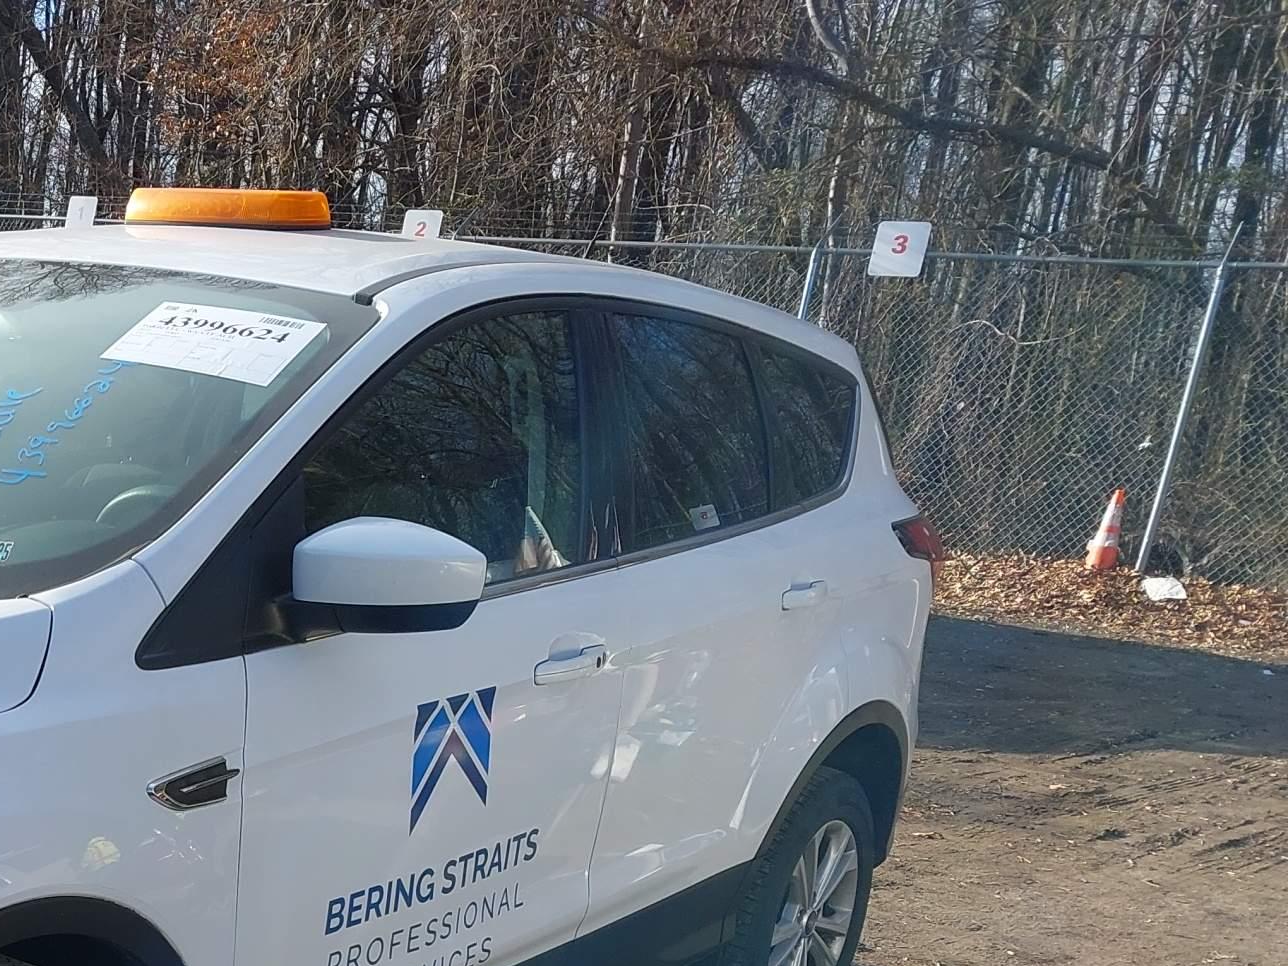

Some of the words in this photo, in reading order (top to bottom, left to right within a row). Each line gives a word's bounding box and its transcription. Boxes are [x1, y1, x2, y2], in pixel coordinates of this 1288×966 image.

[414, 221, 427, 237] 2
[891, 234, 909, 254] 3
[159, 315, 292, 344] 43996624
[324, 868, 435, 935] BERING
[441, 829, 539, 894] STRAITS
